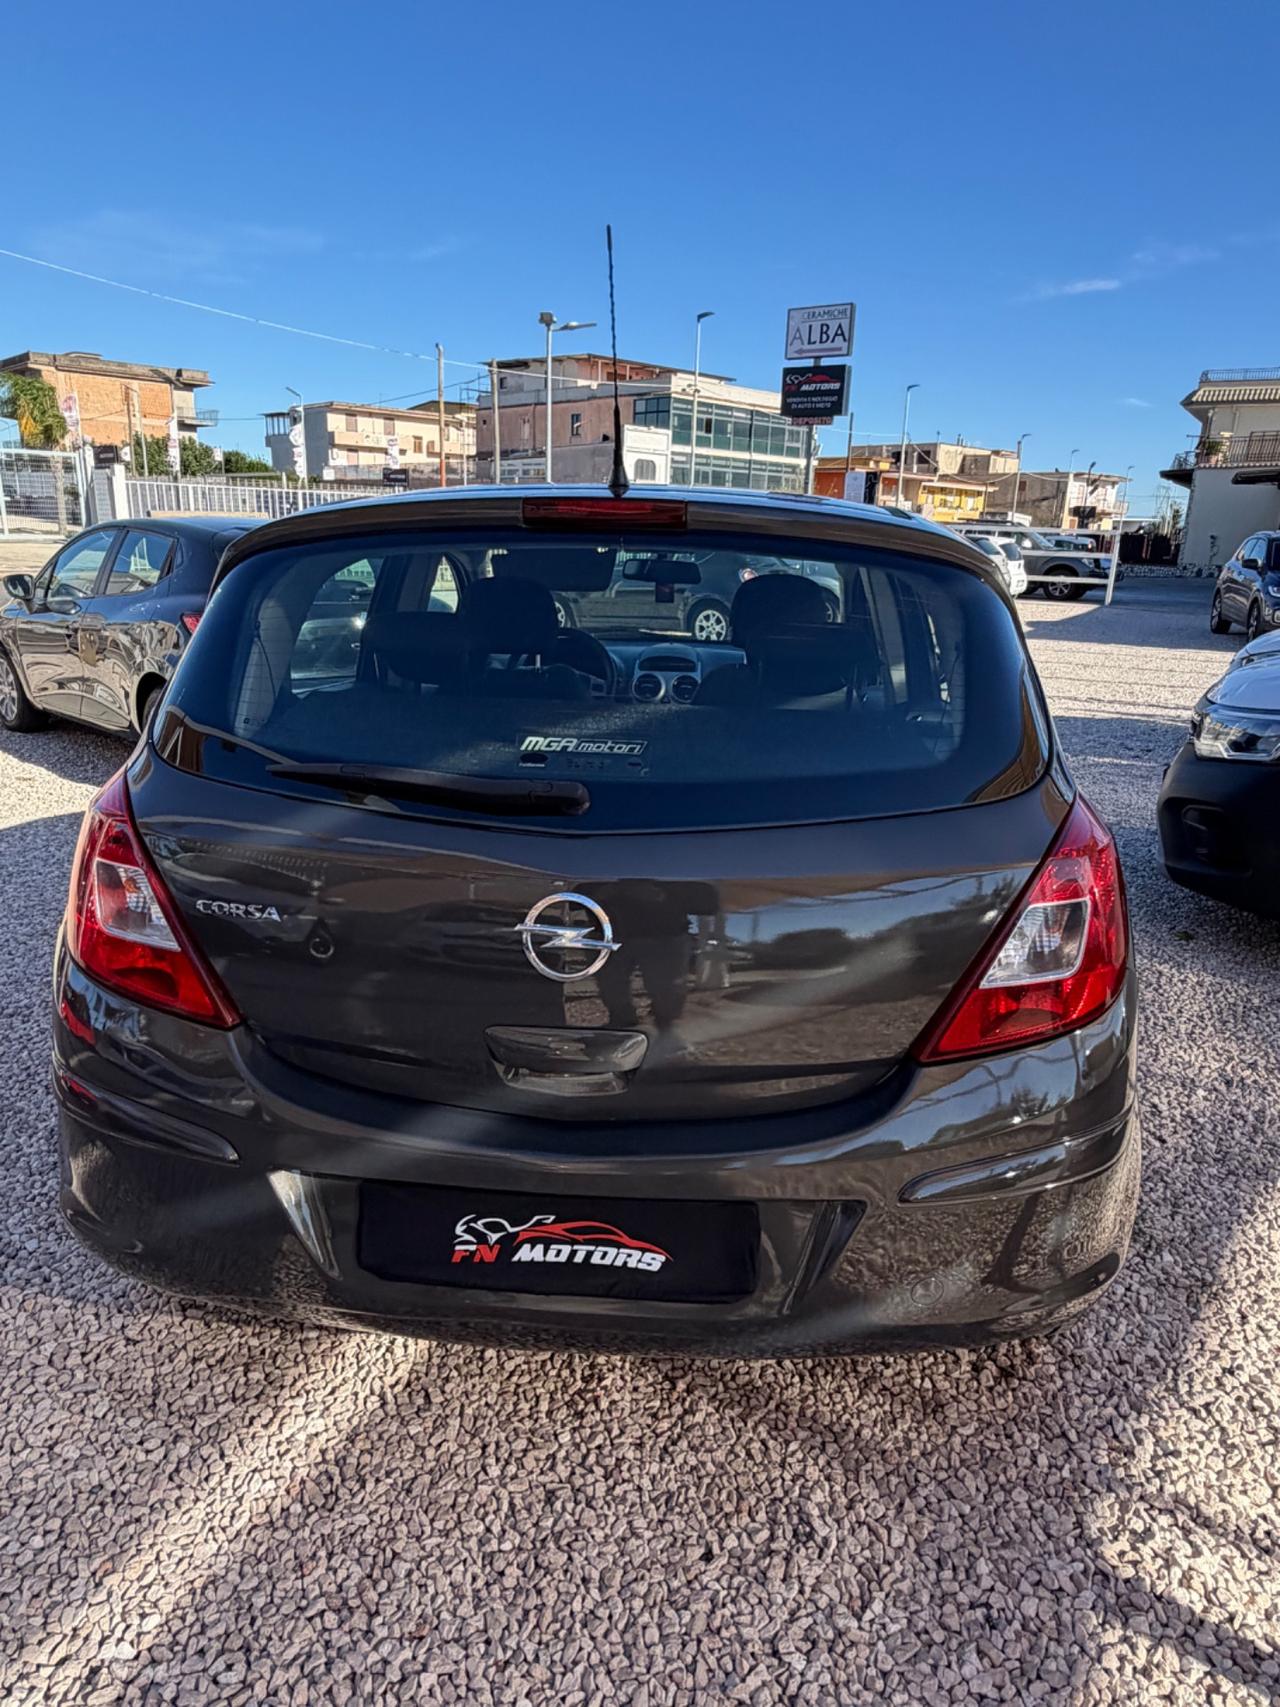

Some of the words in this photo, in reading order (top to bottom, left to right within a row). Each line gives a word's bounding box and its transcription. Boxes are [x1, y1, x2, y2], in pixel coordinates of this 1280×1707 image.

[802, 308, 848, 319] CERAMICHE
[789, 322, 847, 346] ALBA
[801, 383, 840, 391] MOTORS
[520, 736, 577, 752] MGA
[196, 899, 281, 922] CORSA
[451, 1244, 501, 1263] FN
[511, 1243, 666, 1272] MOTORS
